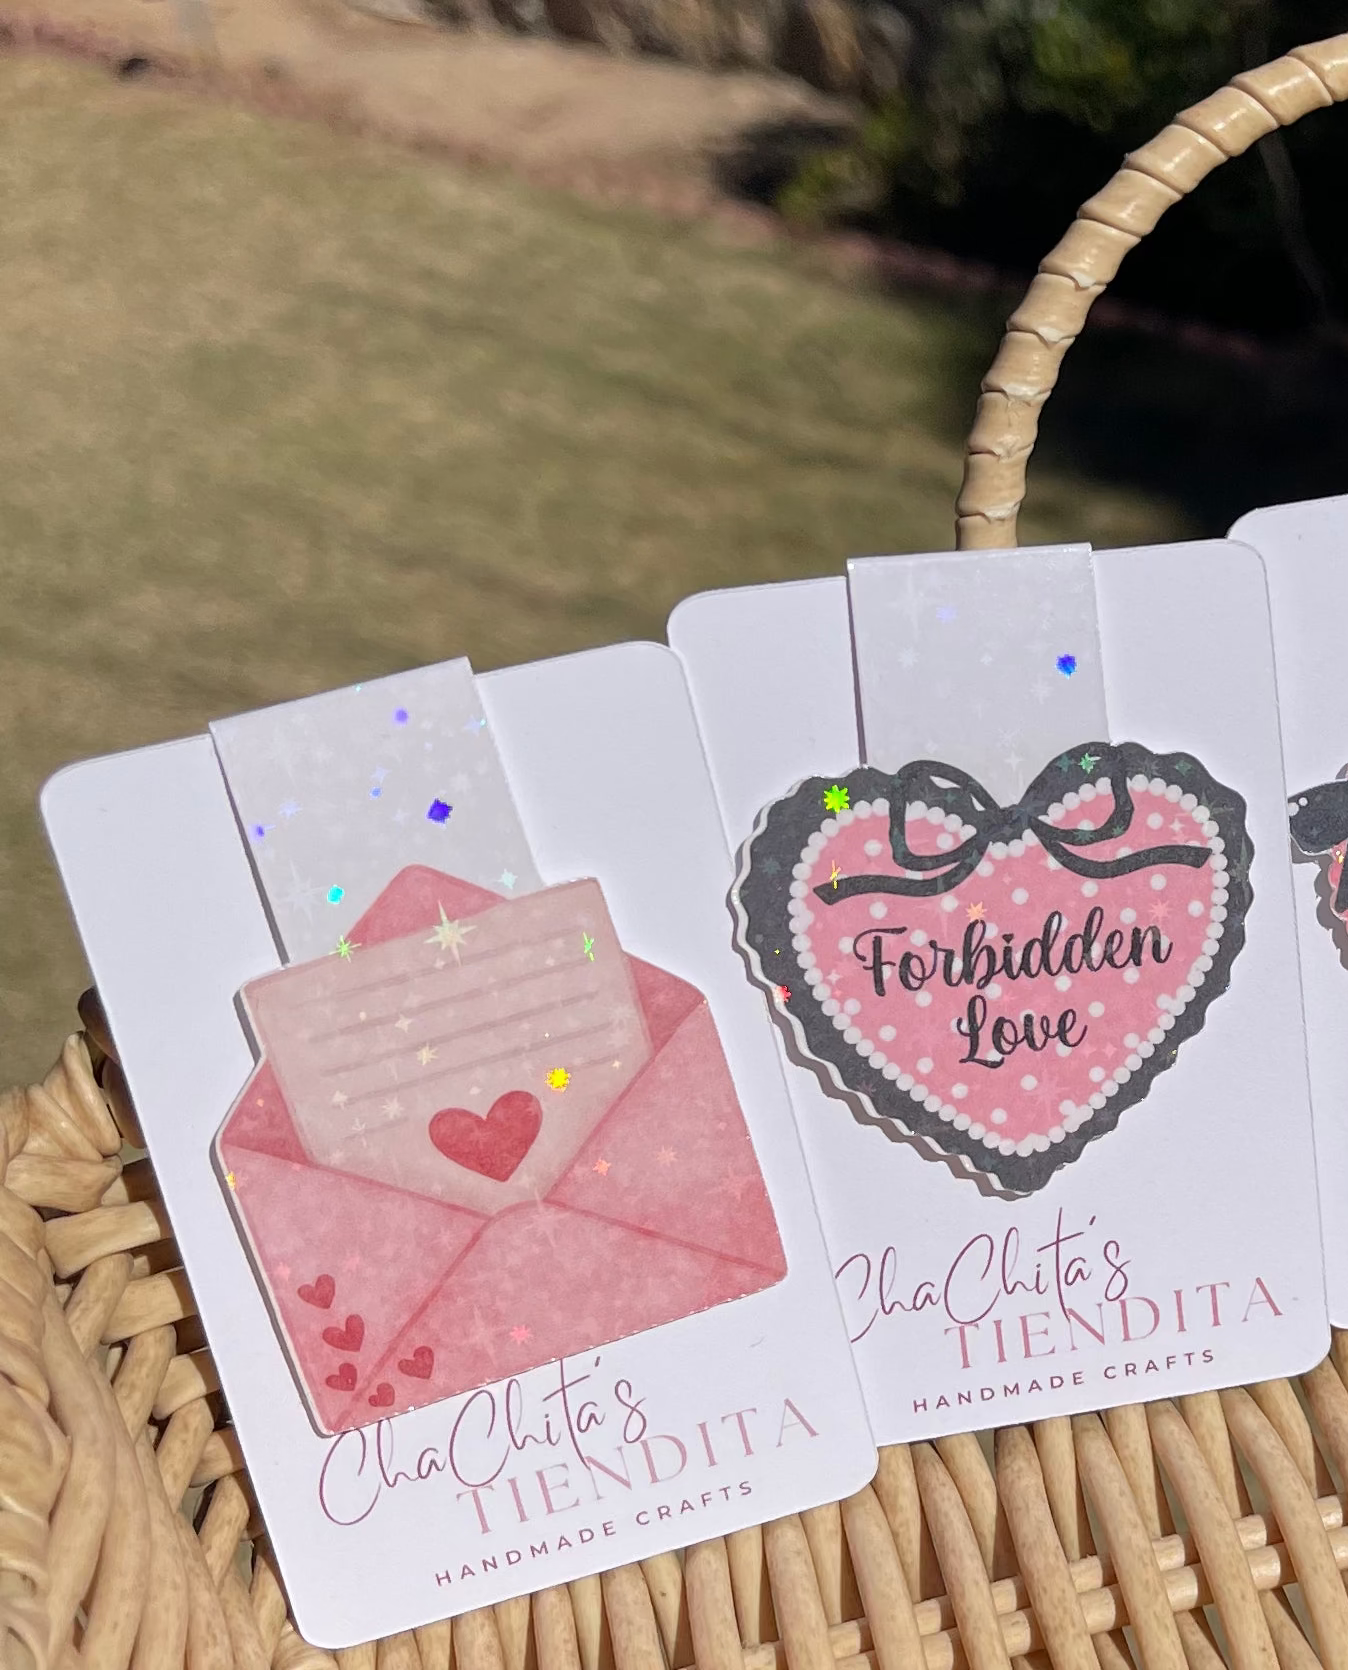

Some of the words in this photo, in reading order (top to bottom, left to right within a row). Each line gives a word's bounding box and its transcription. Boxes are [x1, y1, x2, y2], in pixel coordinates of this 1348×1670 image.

[853, 906, 1173, 997] Forbidden
[957, 995, 1088, 1069] Love
[944, 1276, 1284, 1370] TIENDITA
[913, 1370, 1086, 1413] HANDMADE
[1104, 1349, 1217, 1380] CRAFTS
[319, 1356, 647, 1525] ChaChita's
[456, 1397, 820, 1536] TIENDITA
[434, 1520, 618, 1587] HANDMADE
[636, 1479, 754, 1526] CRAFTS
